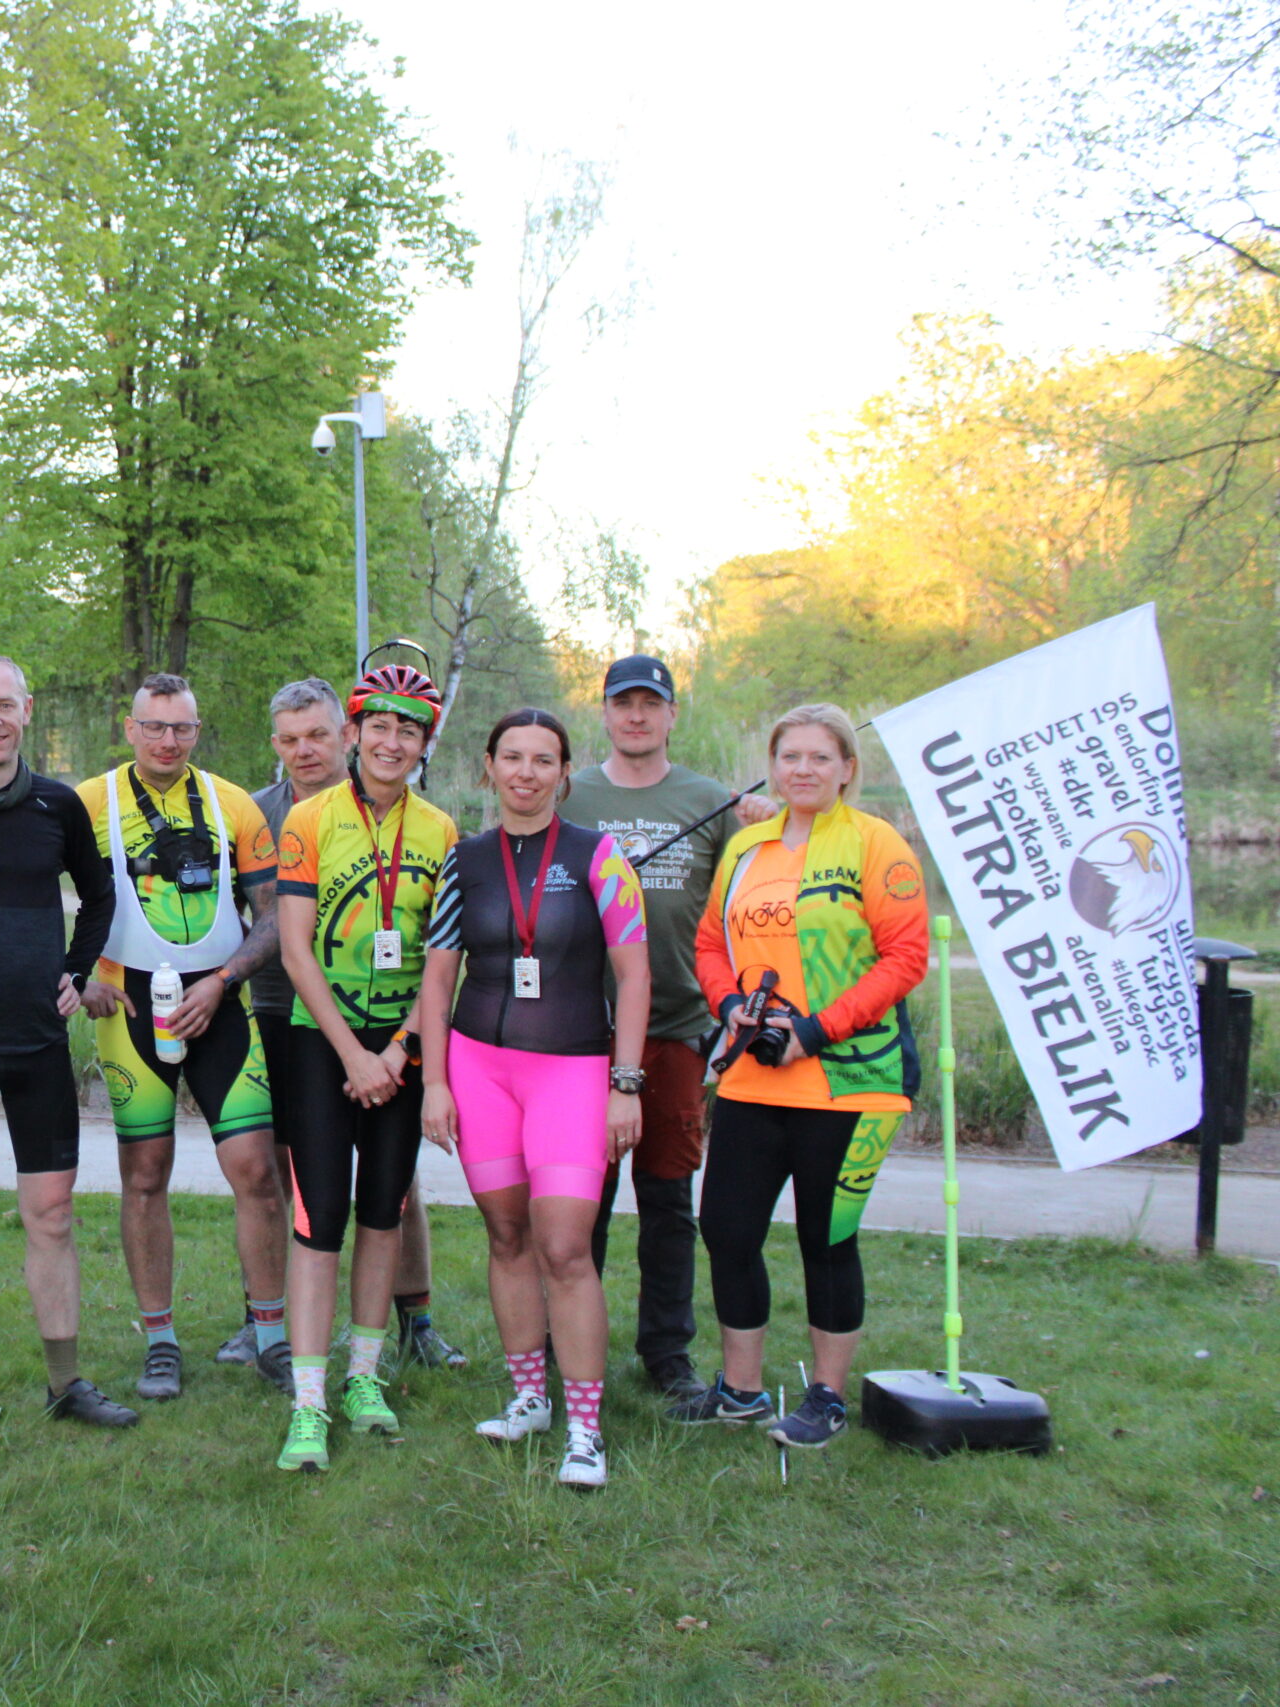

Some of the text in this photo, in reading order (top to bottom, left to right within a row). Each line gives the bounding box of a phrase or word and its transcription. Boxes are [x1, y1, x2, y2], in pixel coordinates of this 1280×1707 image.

[985, 692, 1138, 769] GREVET 195
[1075, 736, 1142, 813] gravel
[1114, 723, 1165, 817] endorfiny
[598, 819, 634, 832] Dolina
[636, 818, 681, 835] Baryczy
[1023, 761, 1073, 849] wyzwanie
[1058, 757, 1096, 819] #dkr
[641, 877, 685, 890] BIELIK
[992, 776, 1062, 901] spotkania
[921, 730, 1131, 1142] ULTRA BIELIK
[1065, 935, 1131, 1056] adrenalina
[1110, 958, 1160, 1068] #lukegroxc
[1136, 954, 1188, 1082] turystyka
[1148, 928, 1201, 1058] przygoda
